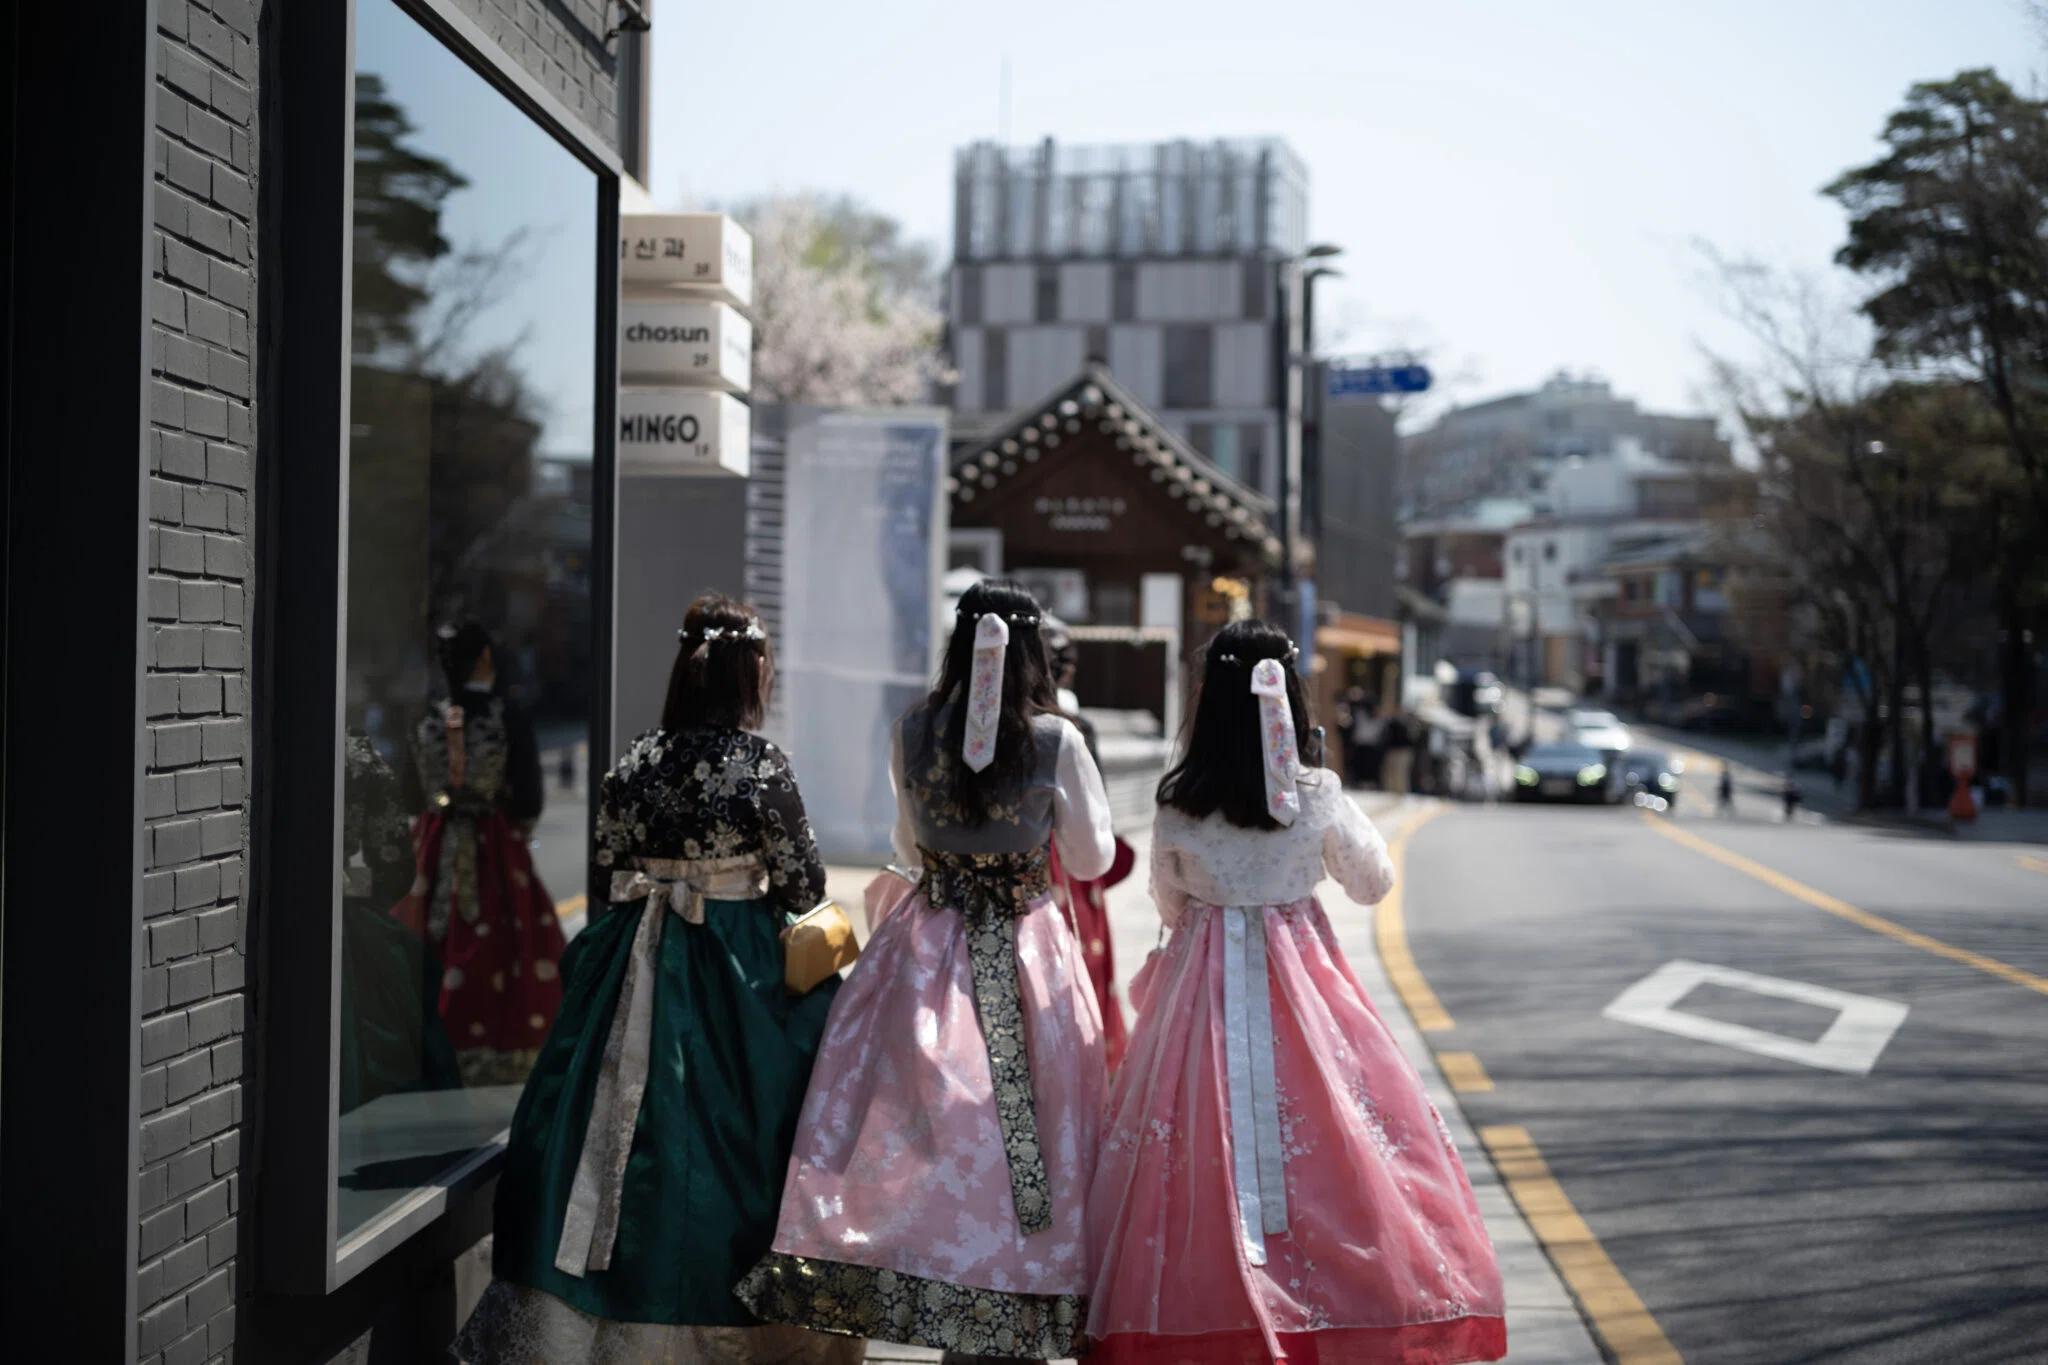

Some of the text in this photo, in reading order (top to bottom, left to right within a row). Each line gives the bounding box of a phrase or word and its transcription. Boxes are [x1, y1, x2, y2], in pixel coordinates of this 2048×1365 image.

[625, 321, 710, 343] chosun
[693, 353, 709, 367] 2F
[620, 413, 699, 443] MINGO
